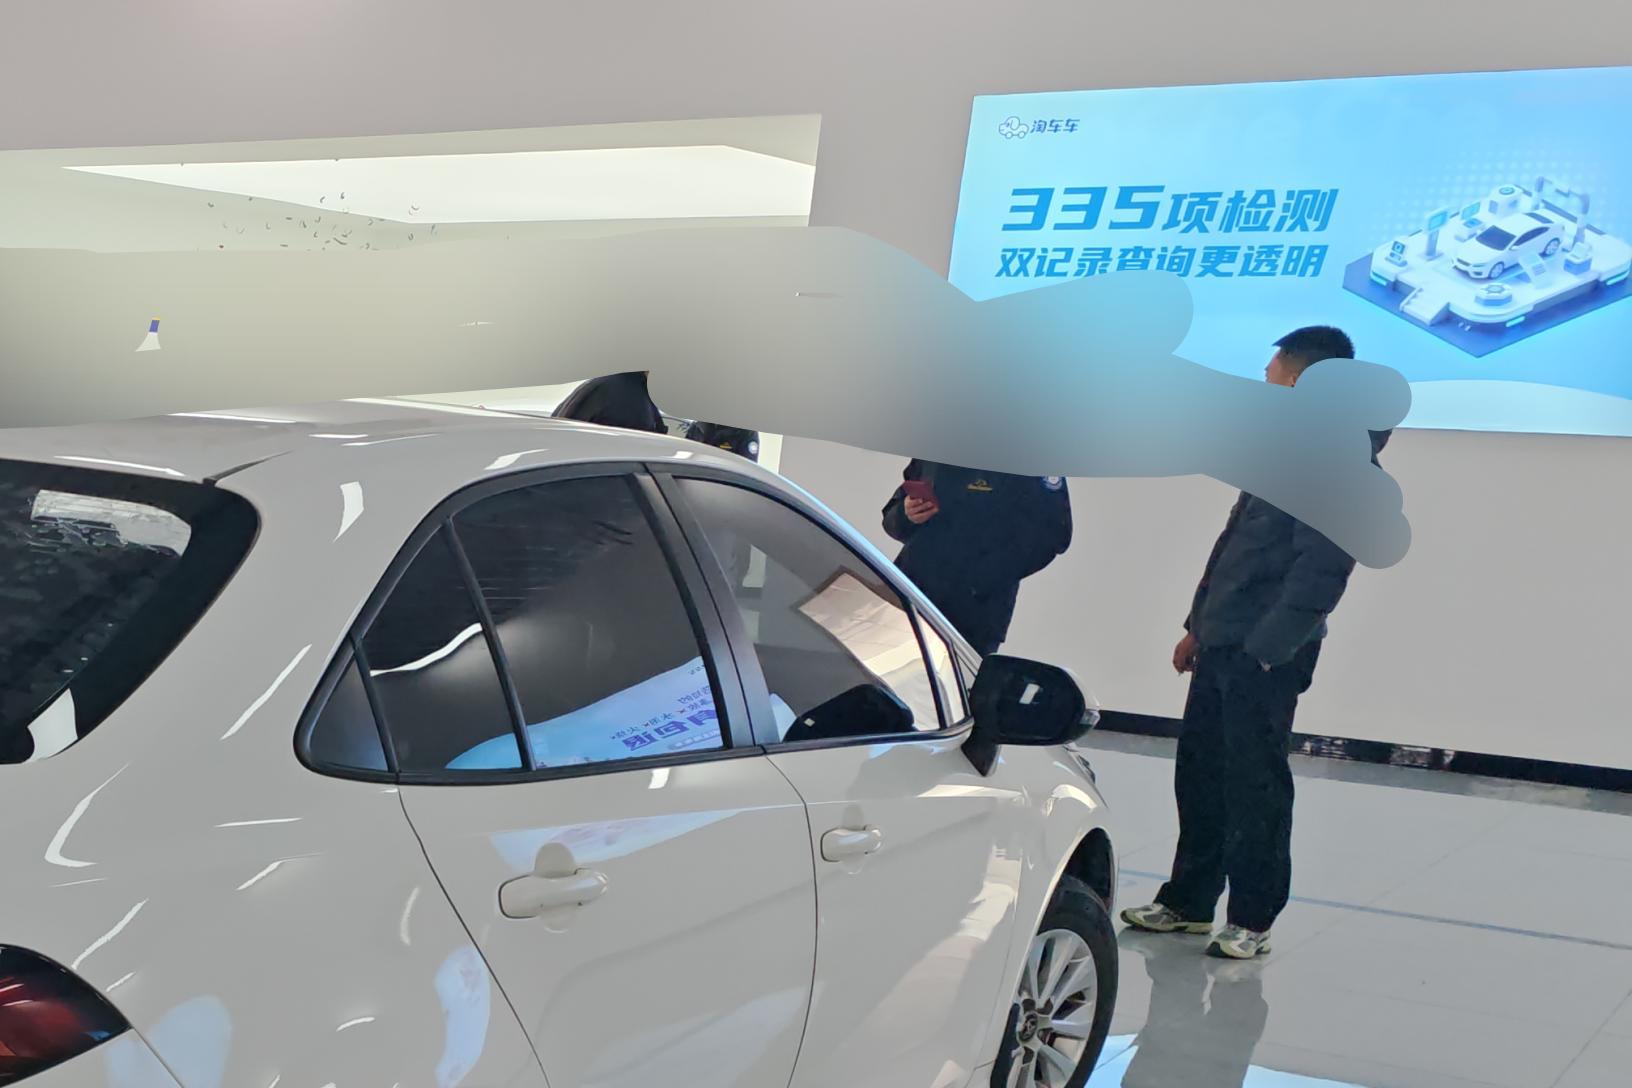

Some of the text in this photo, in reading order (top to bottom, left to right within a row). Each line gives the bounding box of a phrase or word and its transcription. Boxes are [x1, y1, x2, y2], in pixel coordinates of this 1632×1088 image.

[1030, 118, 1081, 134] 淘车车
[1001, 185, 1339, 234] 335项检测
[995, 244, 1330, 278] 双记录查询更透明
